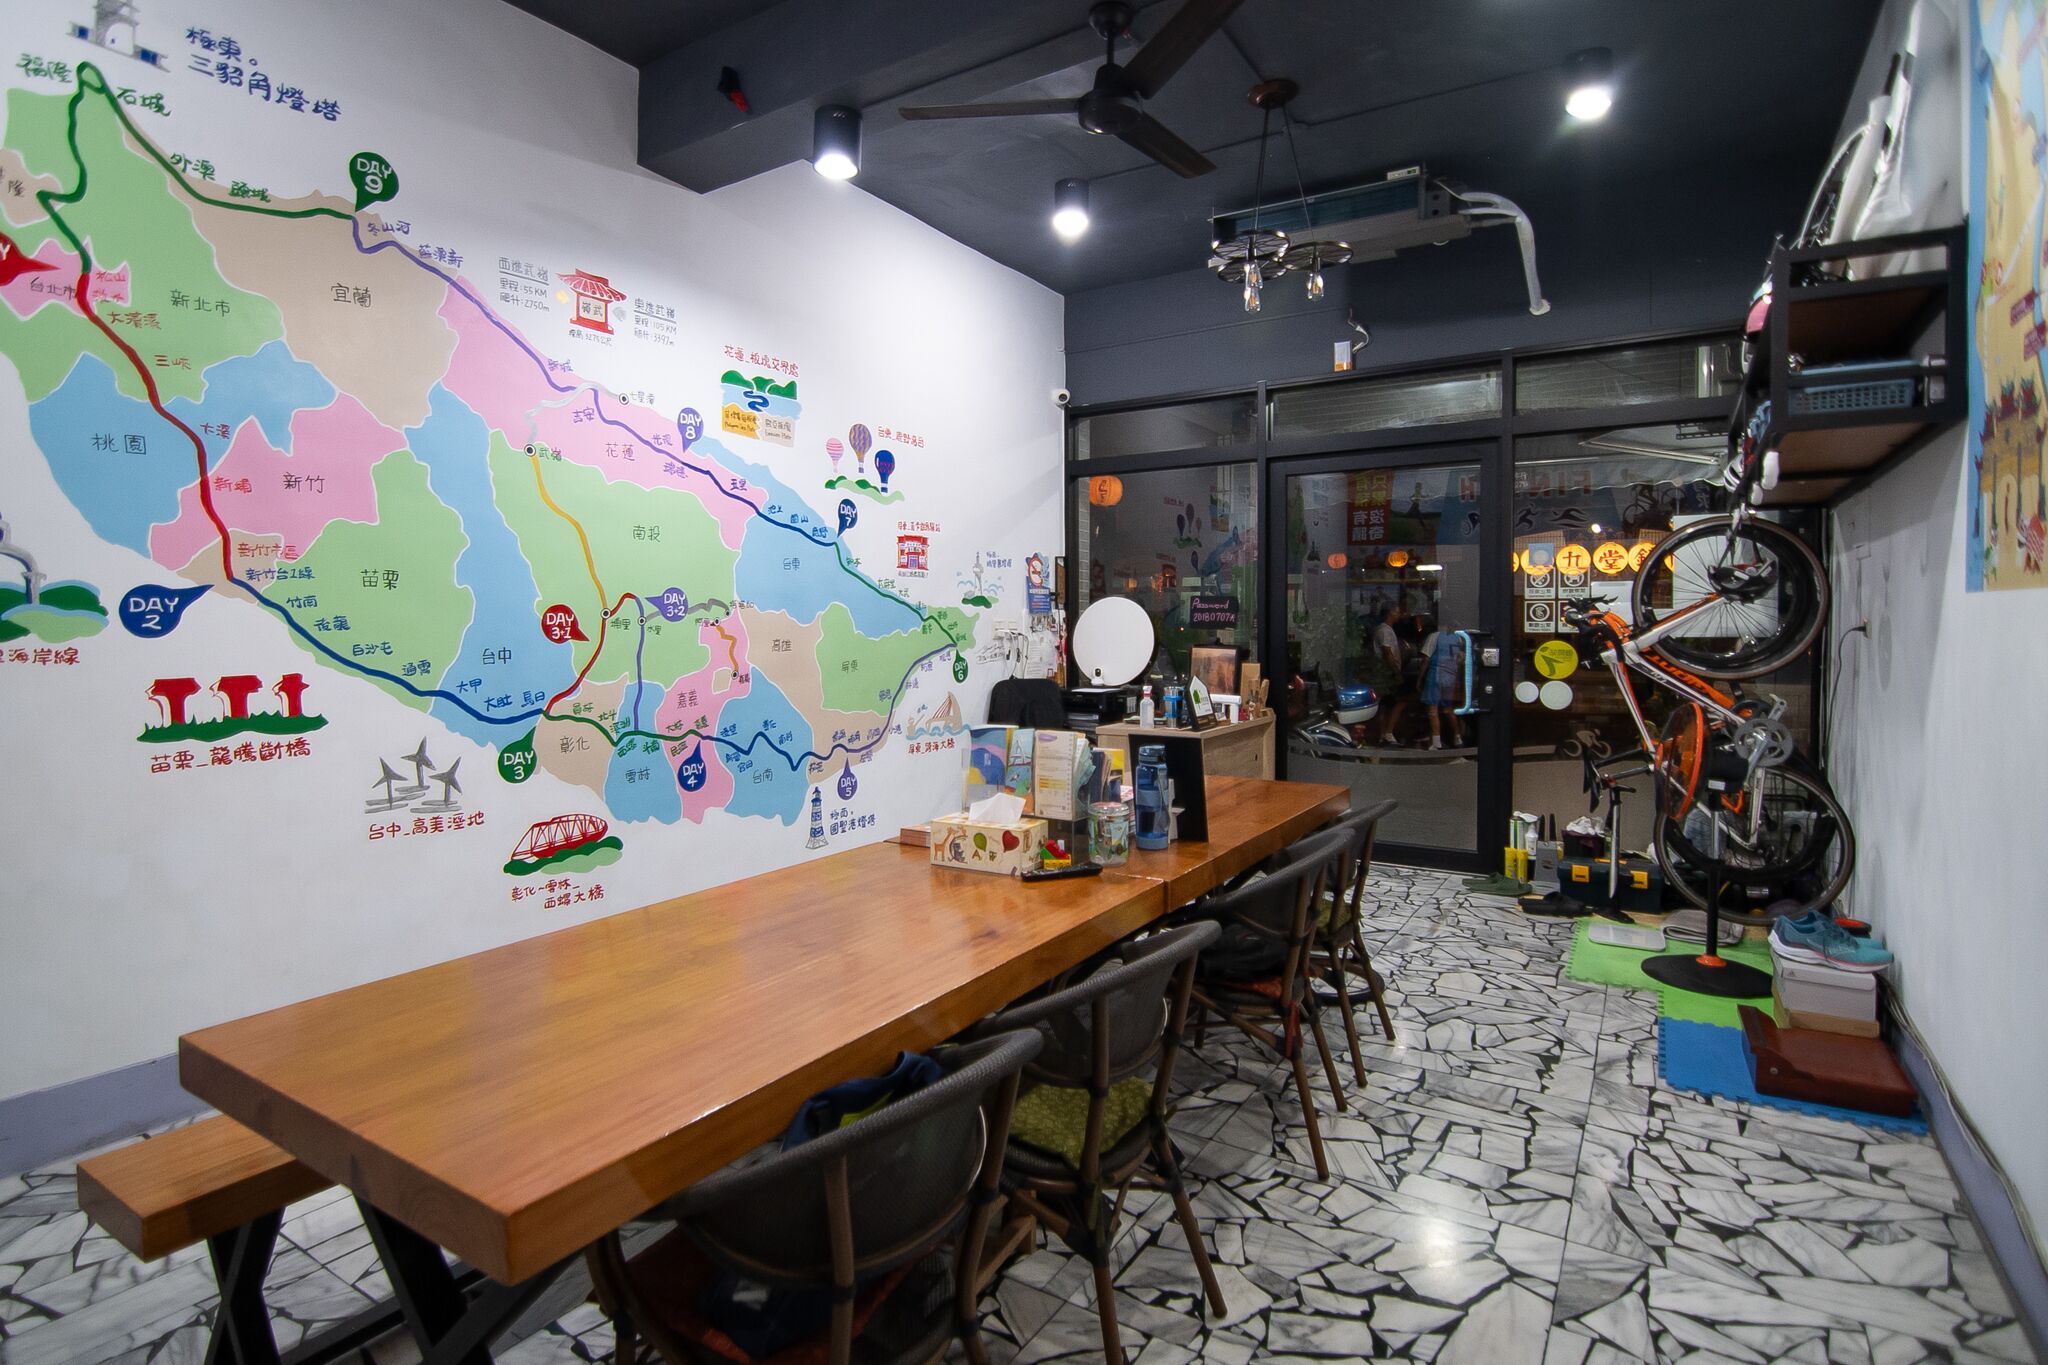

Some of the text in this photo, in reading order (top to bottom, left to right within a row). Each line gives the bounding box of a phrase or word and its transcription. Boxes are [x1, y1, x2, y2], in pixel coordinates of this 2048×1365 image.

[16, 53, 73, 84] 福隆
[116, 87, 171, 117] 石城
[356, 157, 392, 180] DAY
[364, 175, 382, 194] 9
[30, 276, 77, 300] 台北市
[330, 282, 373, 307] 宜蘭
[170, 288, 231, 317] 新北市
[680, 413, 702, 426] DAY
[686, 427, 696, 440] 8
[92, 432, 147, 455] 桃園
[605, 442, 635, 462] 花蓮
[282, 470, 326, 494] 新竹
[840, 504, 858, 519] DAY
[845, 517, 852, 527] 7
[632, 525, 661, 542] 南投
[783, 557, 801, 571] 台東
[360, 568, 399, 590] 苗栗
[129, 597, 180, 614] DAY
[664, 593, 687, 605] DAY
[1192, 598, 1229, 609] Password
[546, 612, 575, 626] DAY
[666, 606, 686, 617] 3+2
[141, 614, 163, 630] 2
[551, 627, 572, 640] 3+1
[352, 640, 394, 658] 白沙屯
[482, 646, 512, 666] 台中
[954, 661, 967, 672] DAY
[957, 671, 964, 680] 6
[456, 678, 482, 694] 大甲
[559, 736, 591, 754] 彰化
[503, 750, 535, 766] DAY
[513, 766, 526, 780] 3
[683, 762, 704, 777] DAY
[753, 767, 774, 784] 台南
[687, 776, 698, 788] 4
[840, 777, 857, 788] DAY
[845, 787, 852, 797] 5
